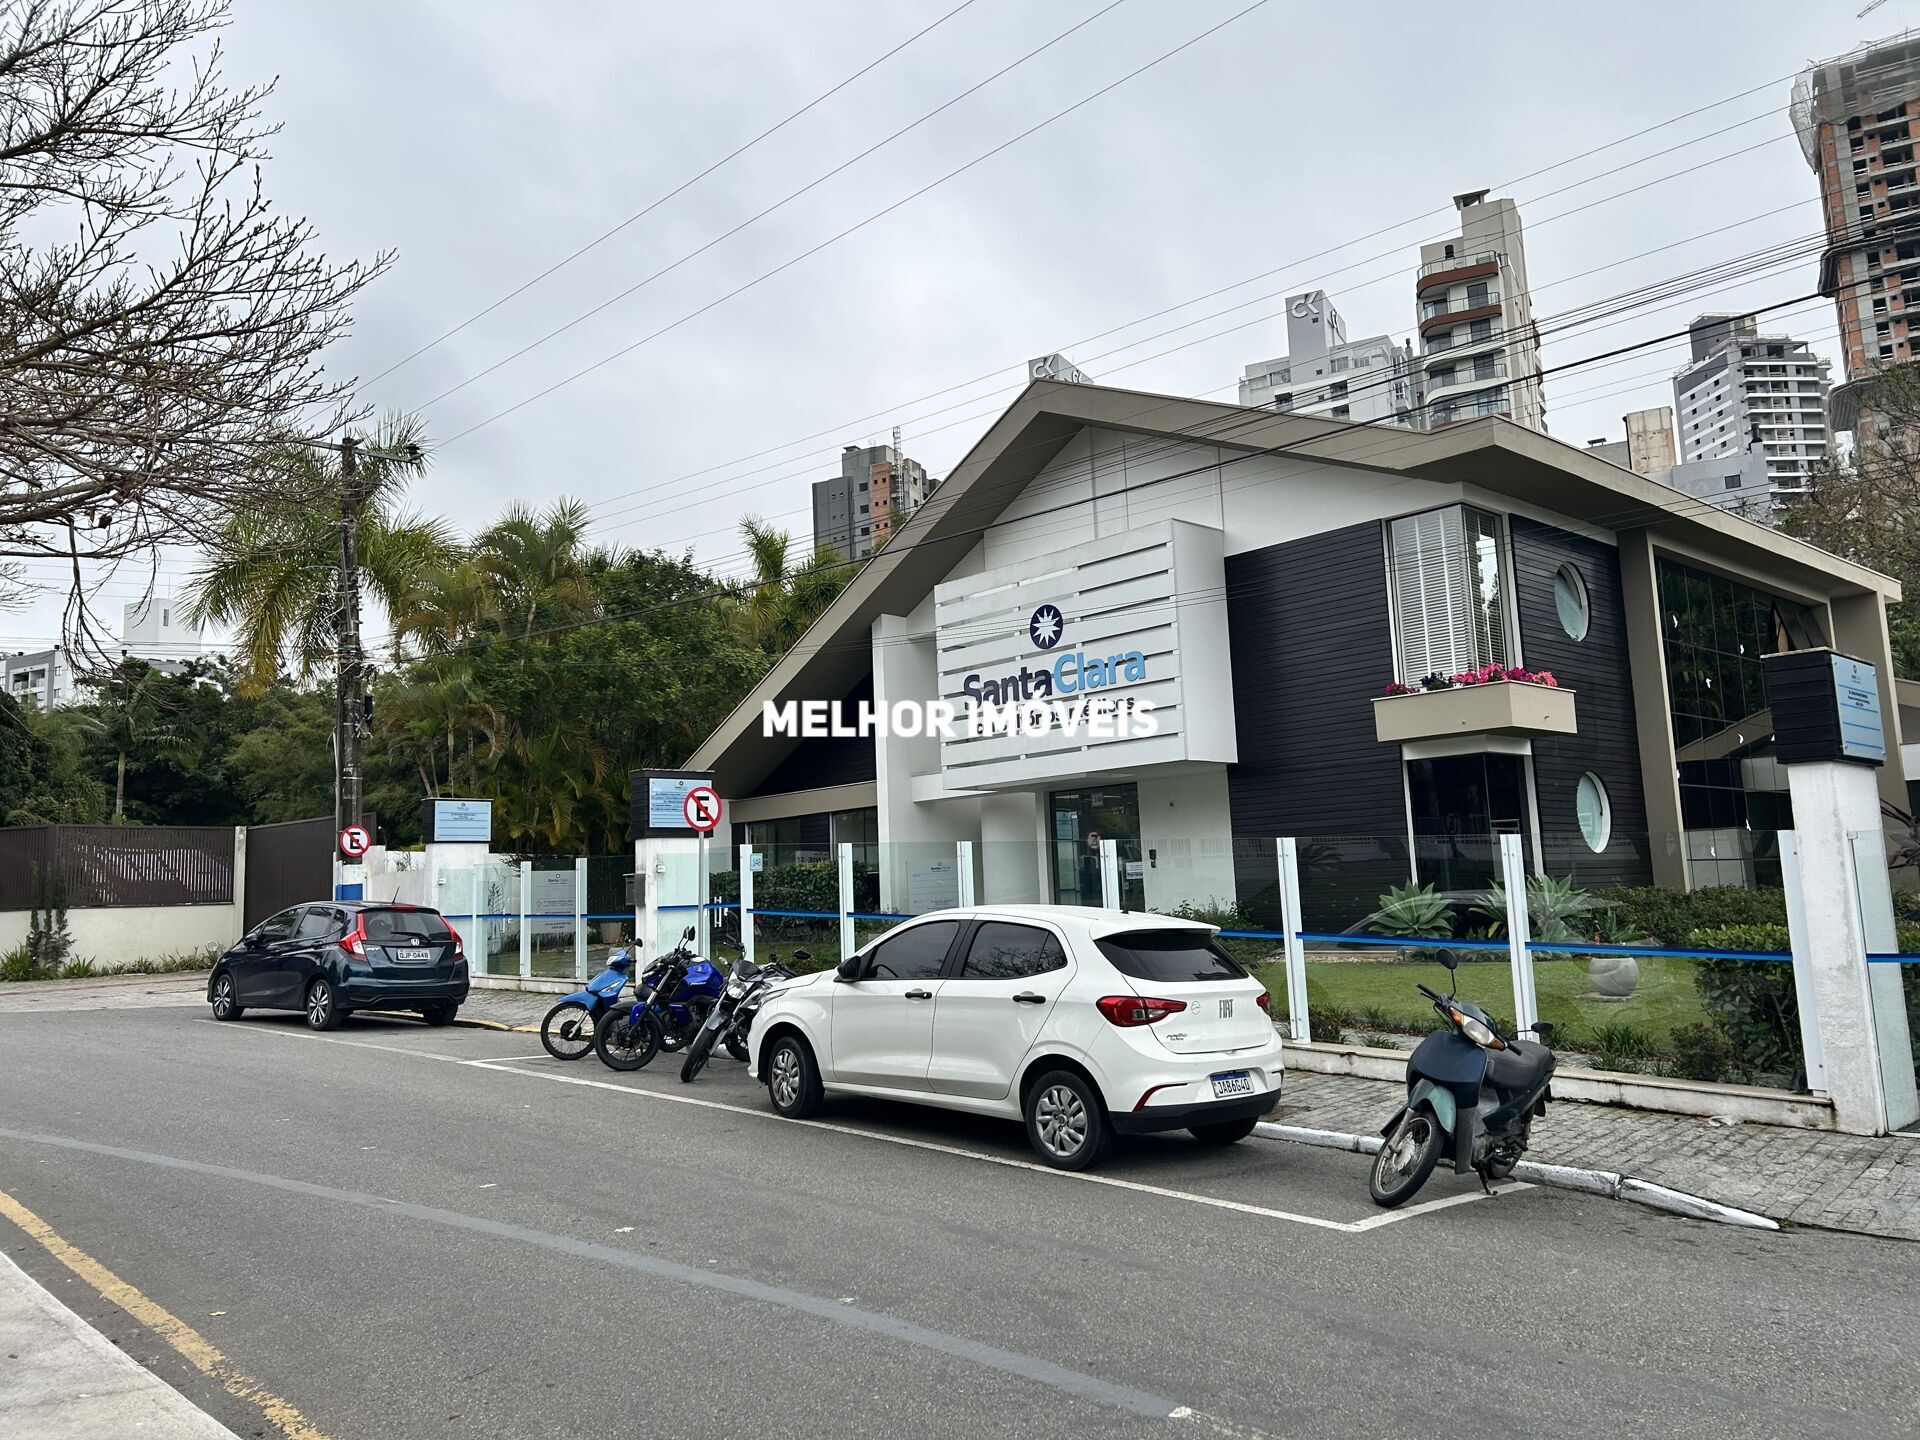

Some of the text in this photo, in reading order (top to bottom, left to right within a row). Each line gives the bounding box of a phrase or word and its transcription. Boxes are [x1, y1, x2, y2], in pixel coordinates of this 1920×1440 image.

[696, 796, 710, 822] E
[349, 831, 361, 850] E
[1218, 998, 1234, 1018] FIAT
